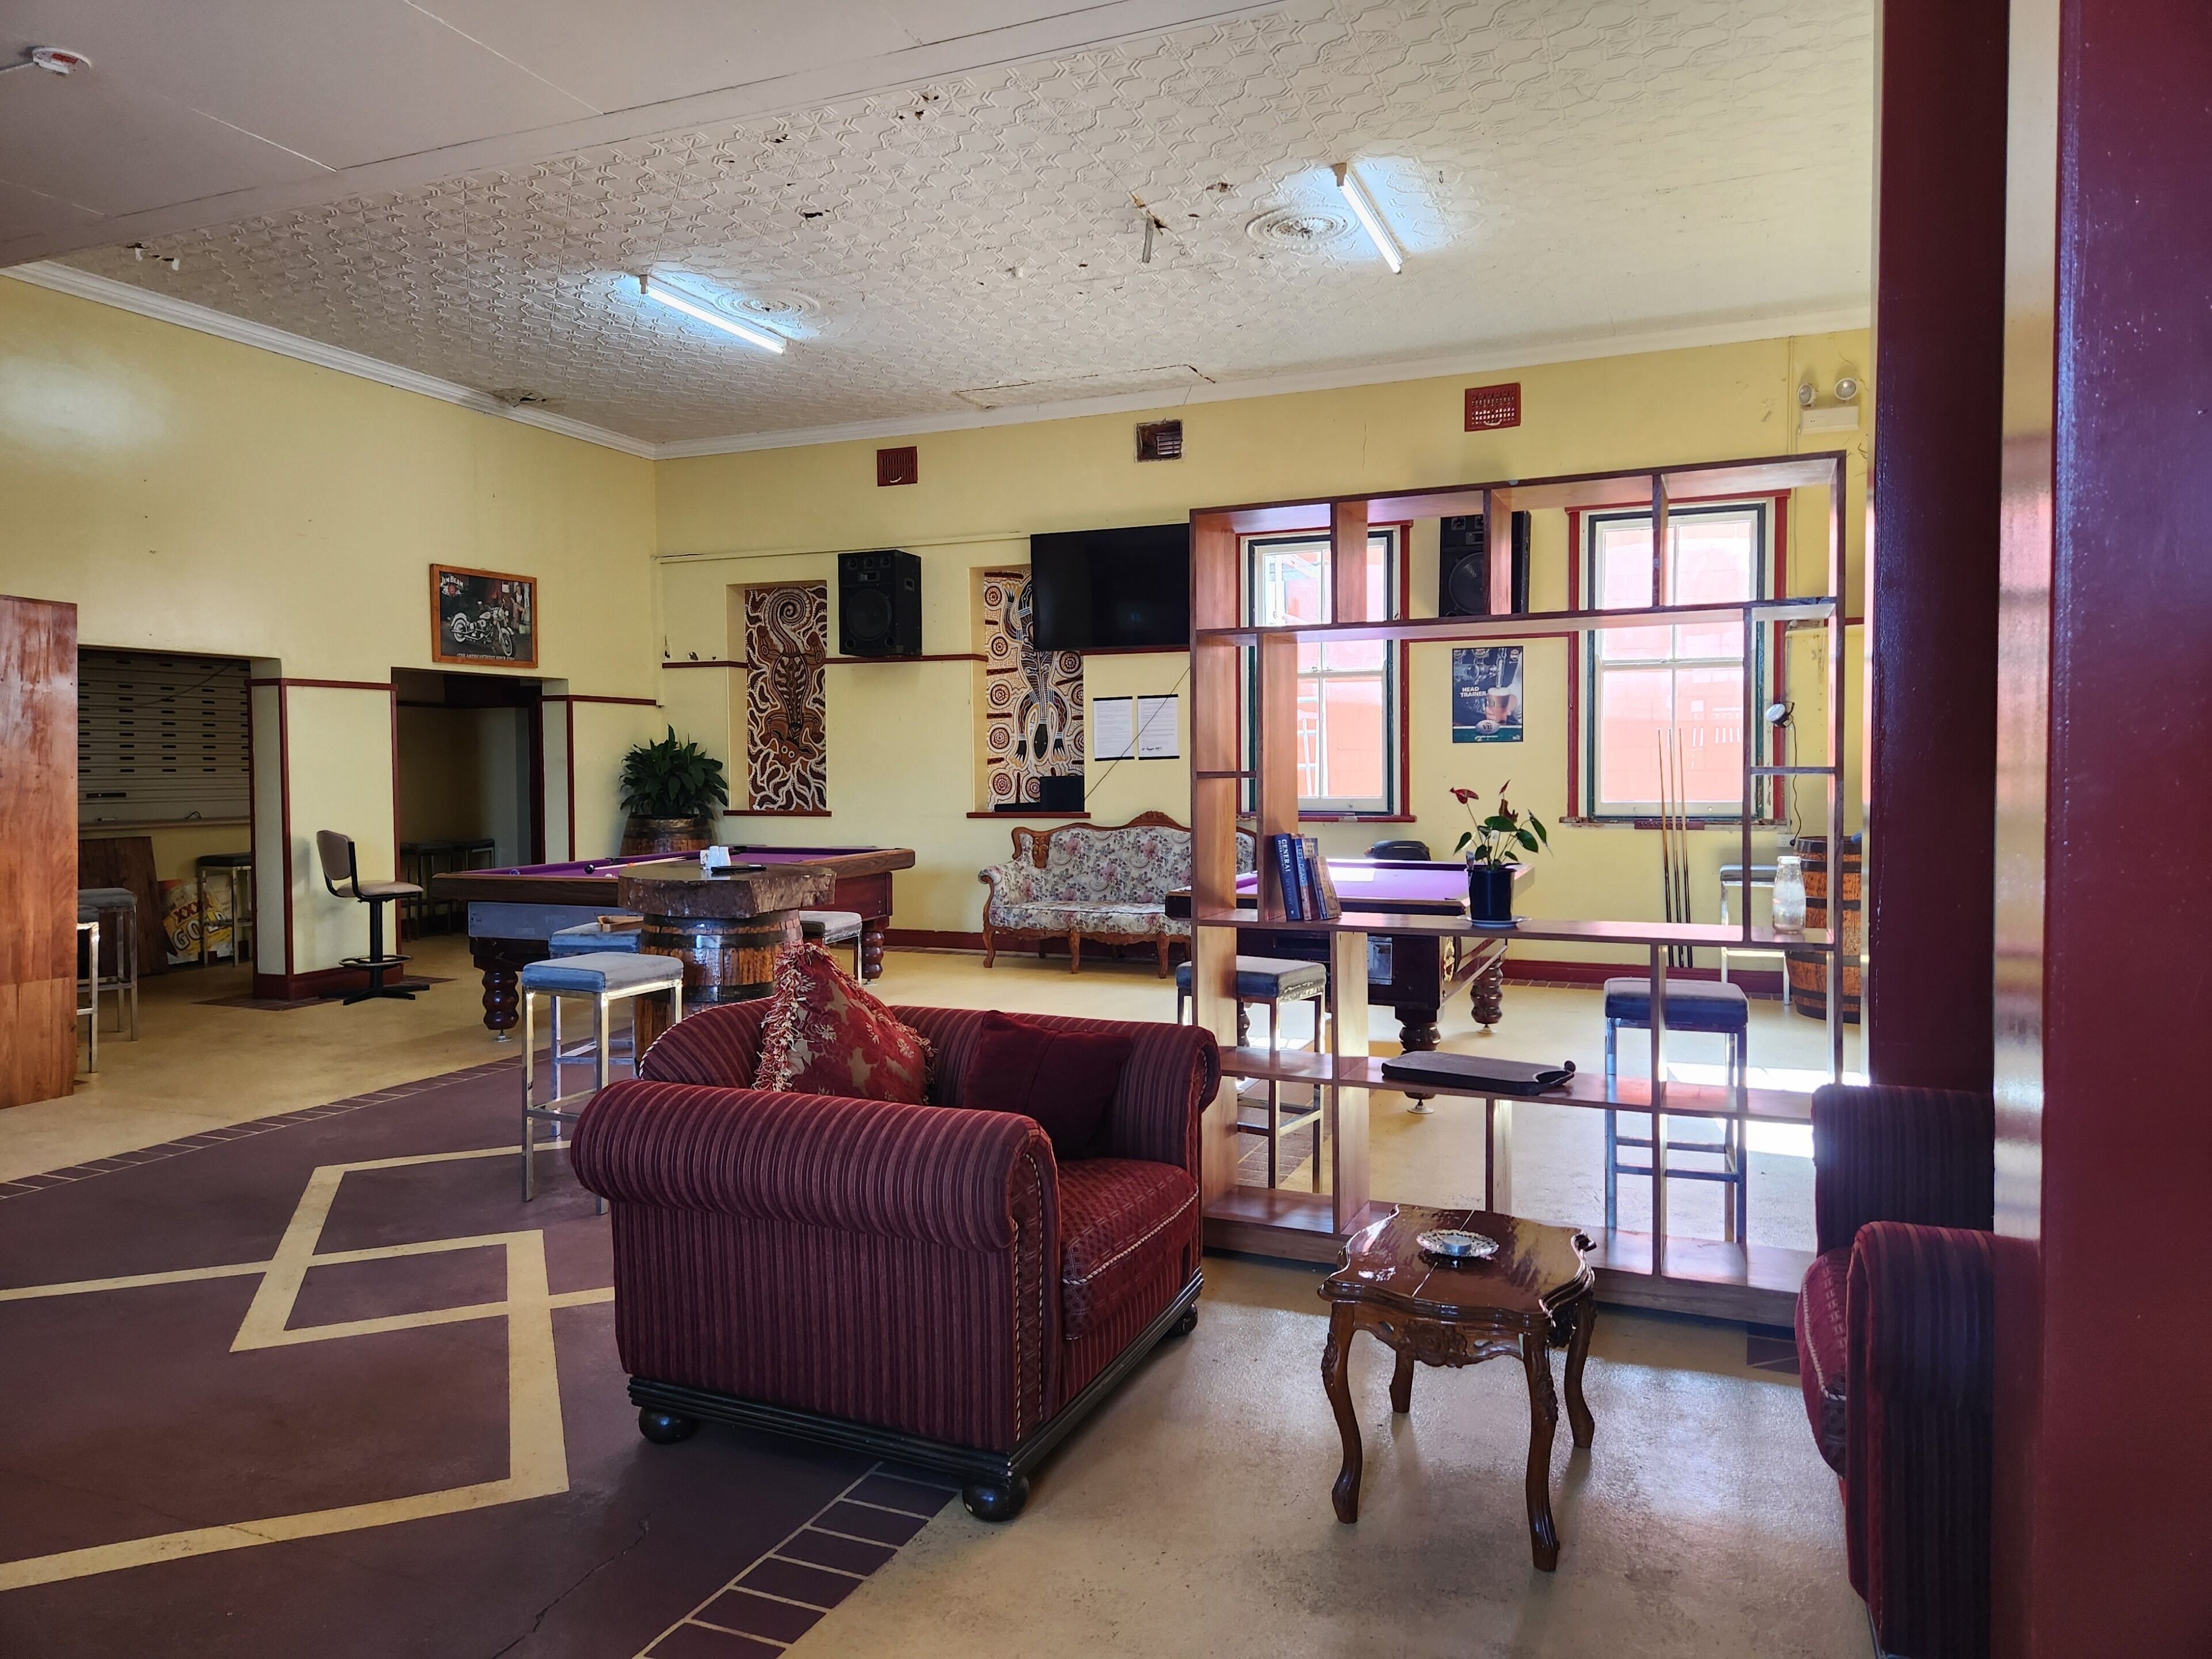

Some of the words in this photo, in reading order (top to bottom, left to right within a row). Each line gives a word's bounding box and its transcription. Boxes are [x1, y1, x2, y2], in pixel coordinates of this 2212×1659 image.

[440, 577, 449, 587] JIM
[450, 575, 464, 588] BEAM
[1282, 839, 1291, 872] GENERAL
